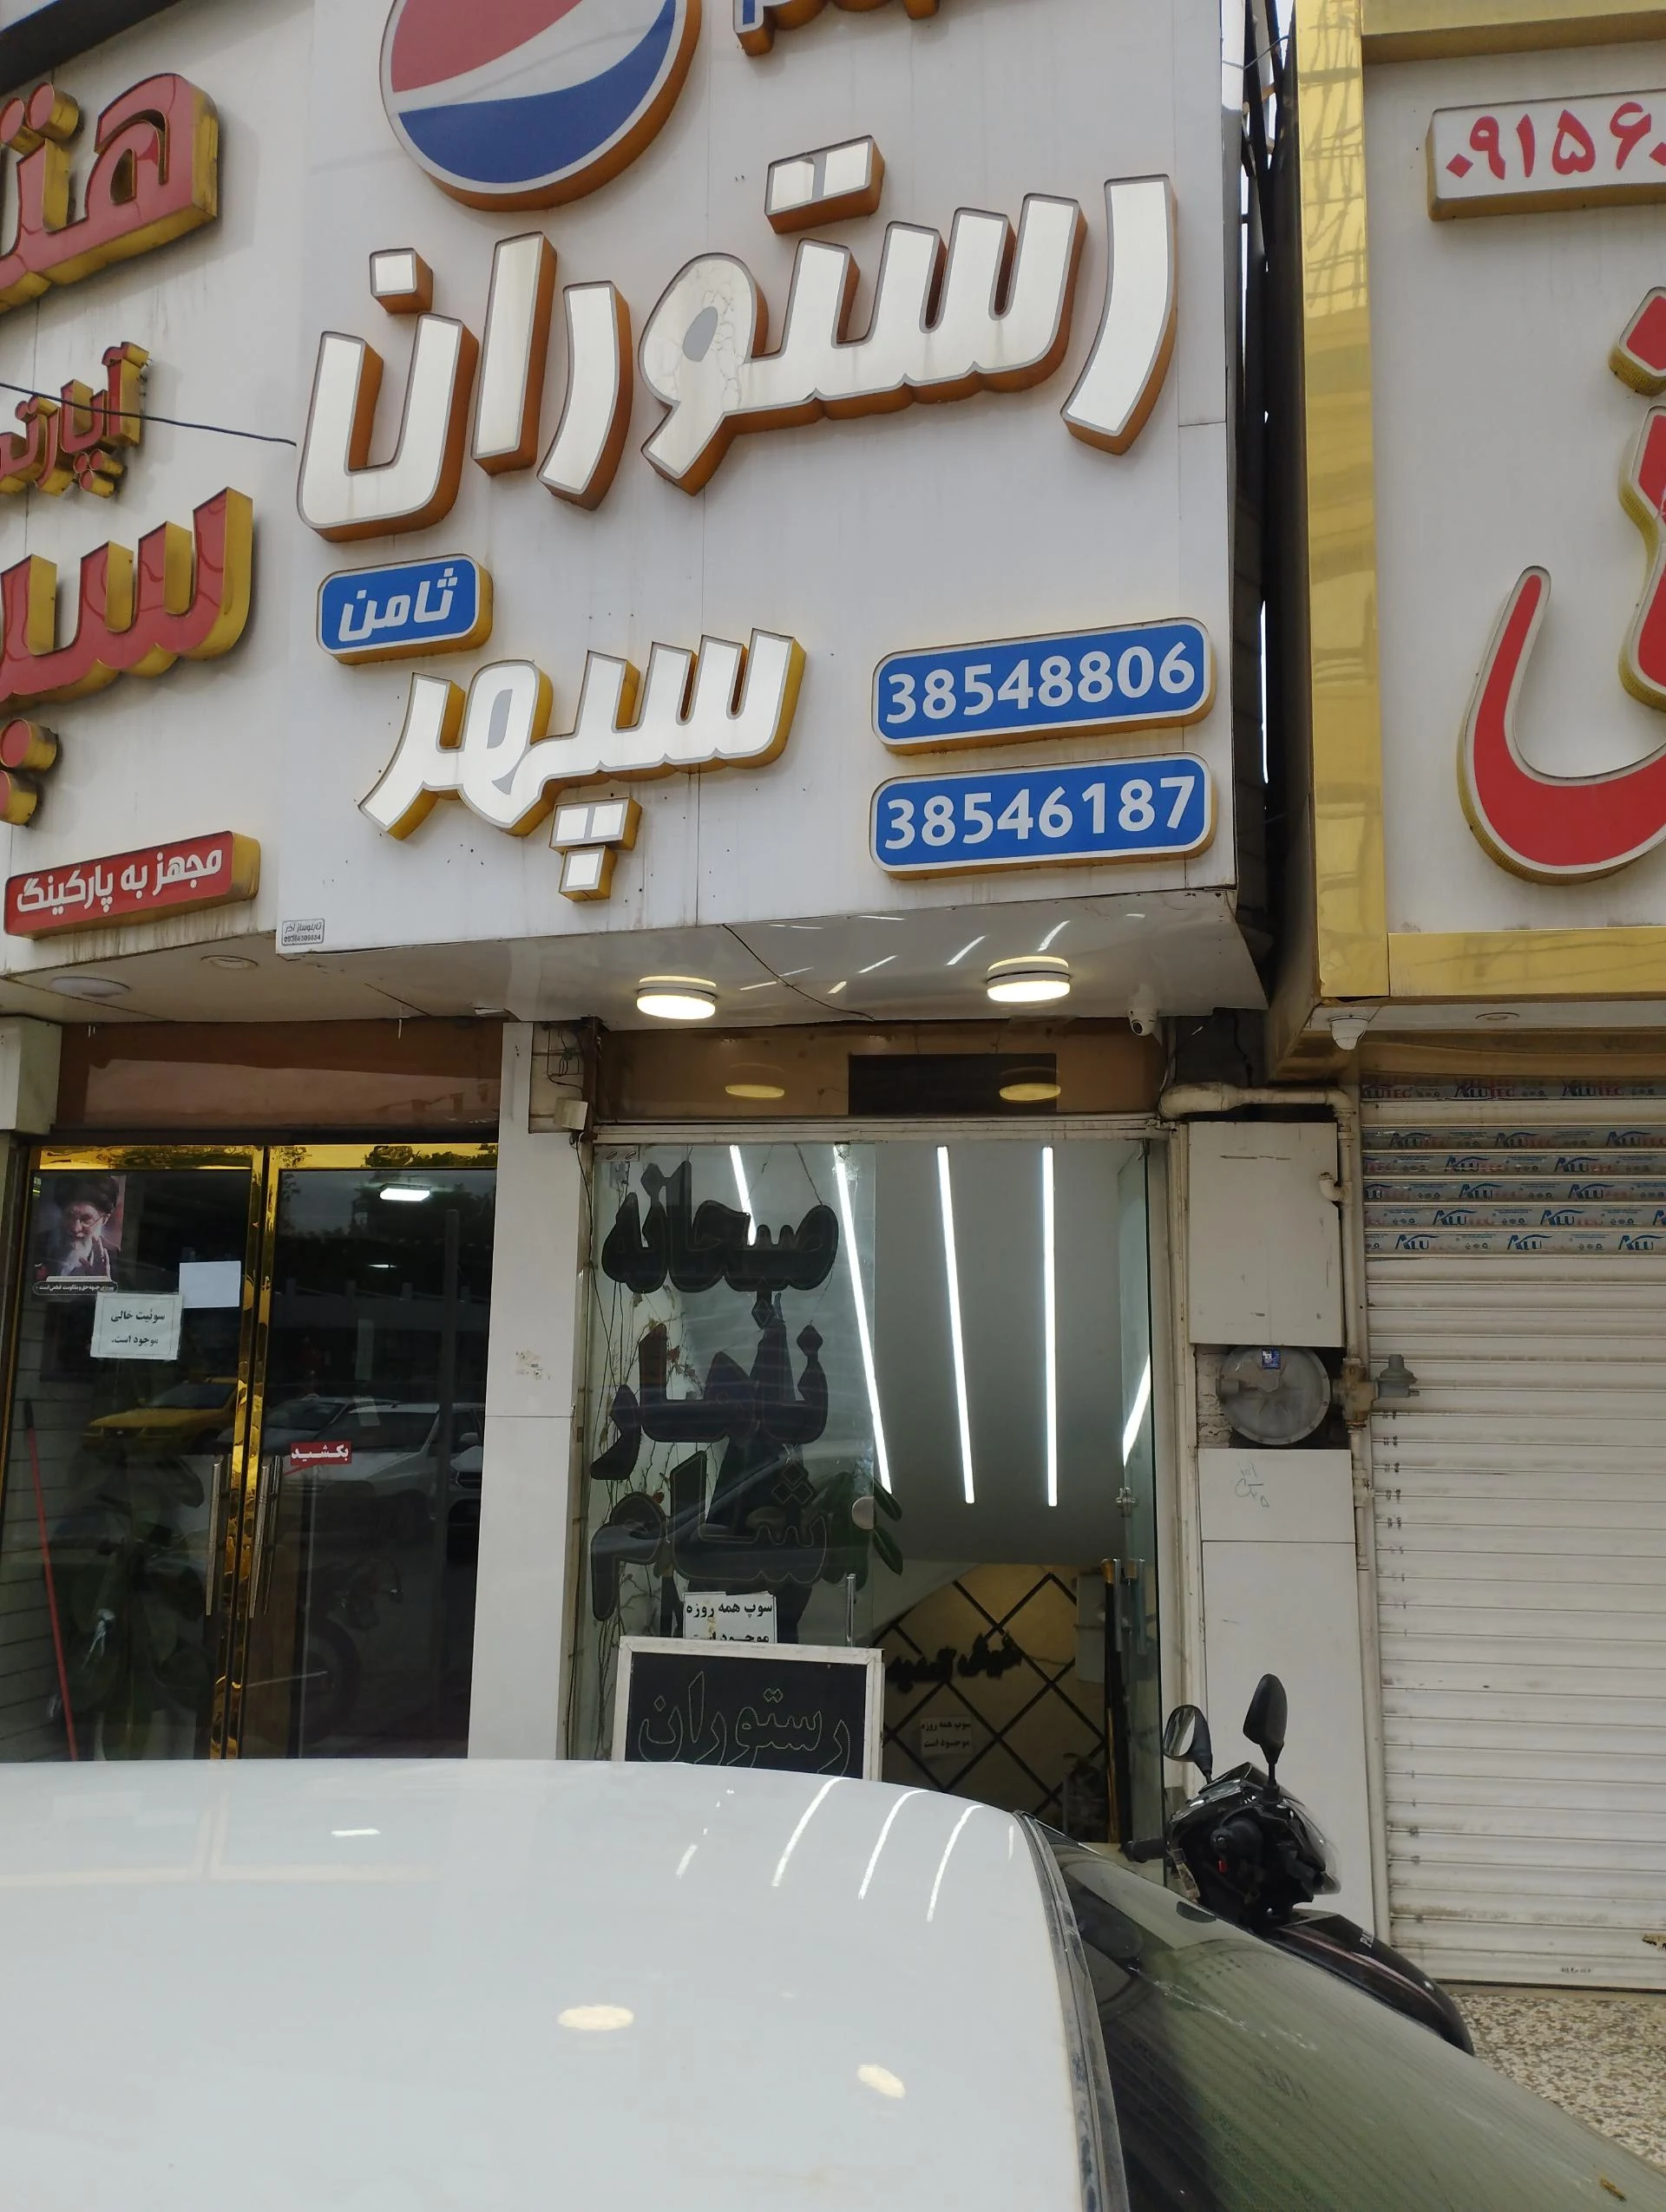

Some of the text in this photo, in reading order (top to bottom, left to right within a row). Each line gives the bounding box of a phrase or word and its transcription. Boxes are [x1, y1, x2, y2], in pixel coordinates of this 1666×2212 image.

[298, 135, 1177, 540] رستوران
[338, 567, 458, 642] ثامن
[886, 641, 1196, 724] 38548806
[357, 628, 803, 897] سپهر
[884, 776, 1196, 850] 38546187
[16, 849, 223, 915] مجهز به پارکینگ
[291, 1443, 349, 1463] بکشید
[685, 1602, 773, 1619] سوپ همه روزه
[638, 1671, 852, 1777] رستوران
